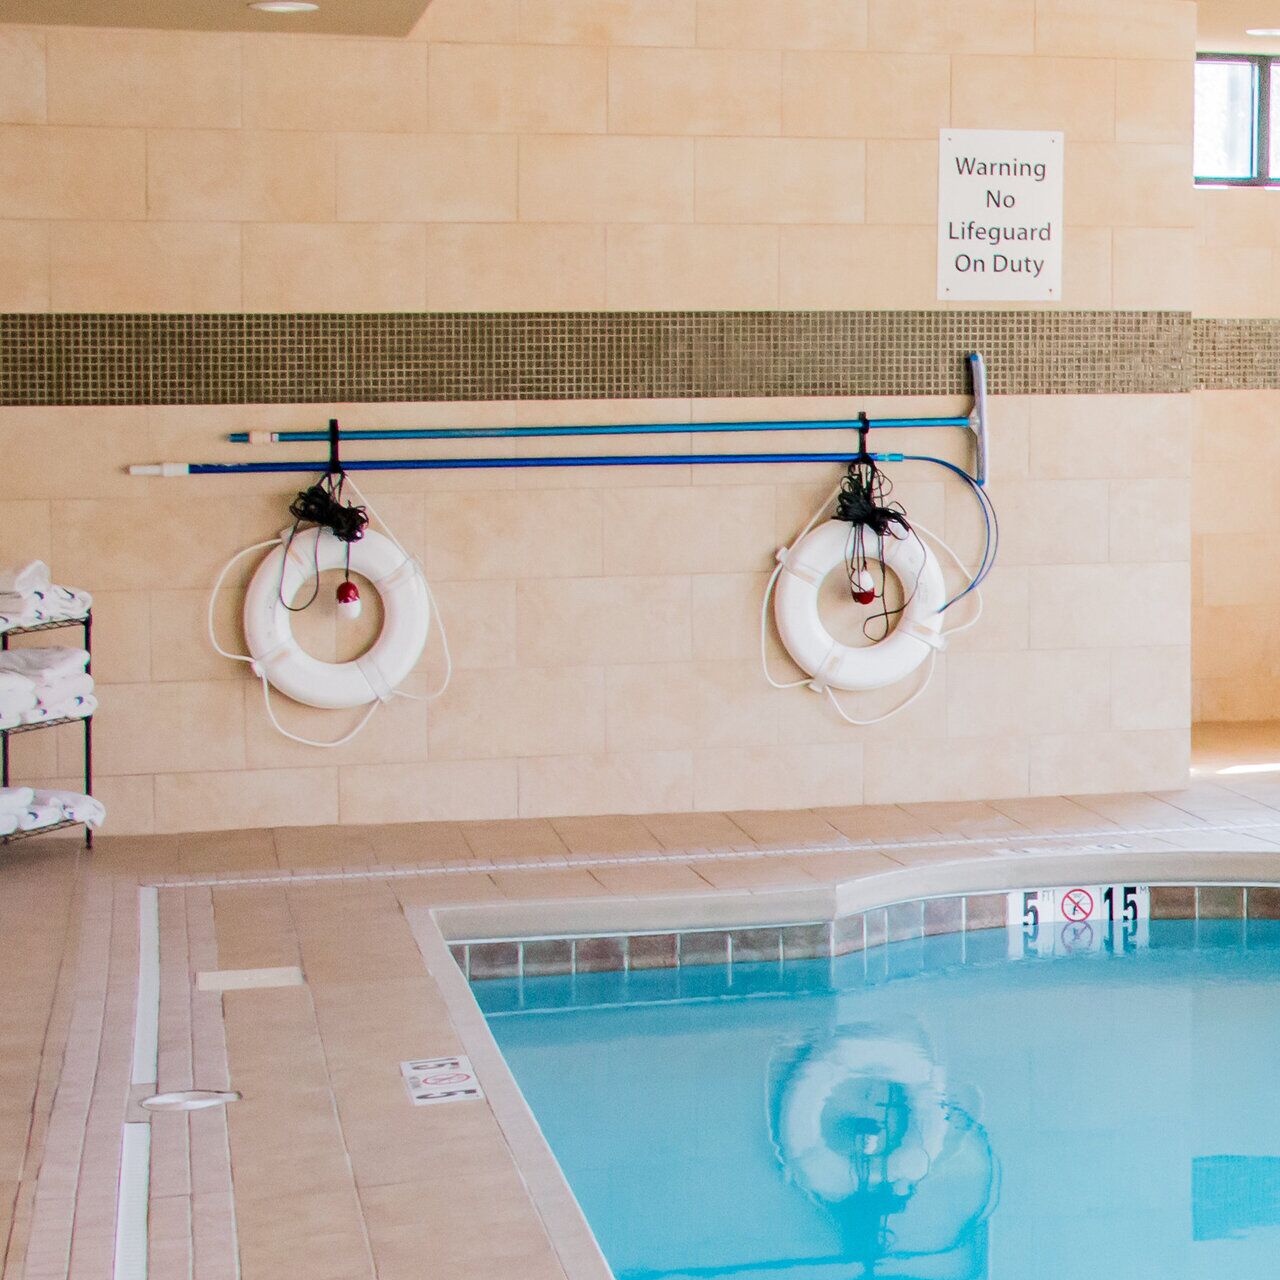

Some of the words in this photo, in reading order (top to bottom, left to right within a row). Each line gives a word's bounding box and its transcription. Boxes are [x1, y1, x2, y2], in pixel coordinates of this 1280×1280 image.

[954, 157, 1046, 181] Warning
[986, 190, 1015, 208] No
[949, 221, 1051, 245] Lifeguard
[955, 254, 985, 272] On
[993, 254, 1044, 278] Duty
[1023, 892, 1039, 925] 5
